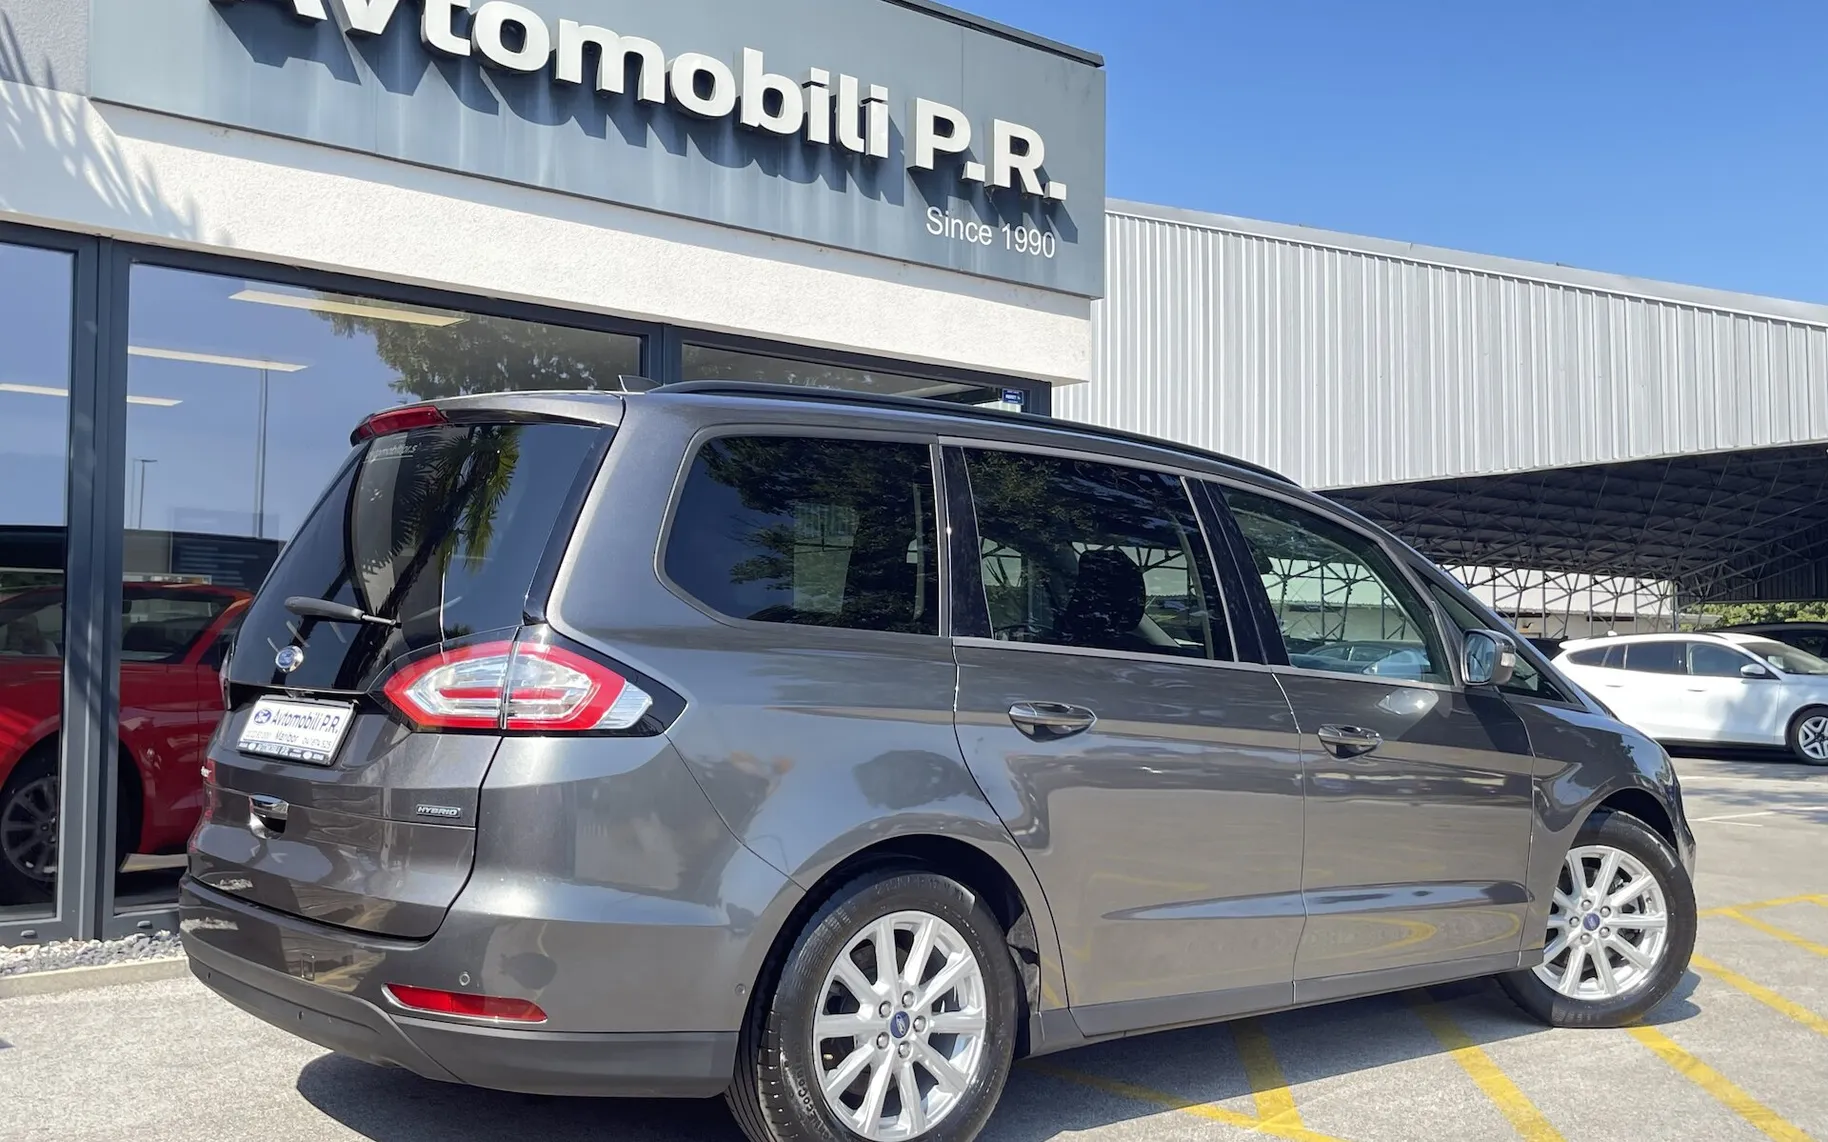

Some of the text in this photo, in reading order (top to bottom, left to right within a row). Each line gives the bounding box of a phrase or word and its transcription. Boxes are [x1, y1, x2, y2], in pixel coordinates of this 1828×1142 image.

[211, 0, 1067, 201] vtomobili P.R.
[926, 206, 1056, 258] Since 1990
[272, 708, 323, 731] Avtomobili
[319, 714, 340, 734] P.R.
[417, 806, 458, 816] HYBRID
